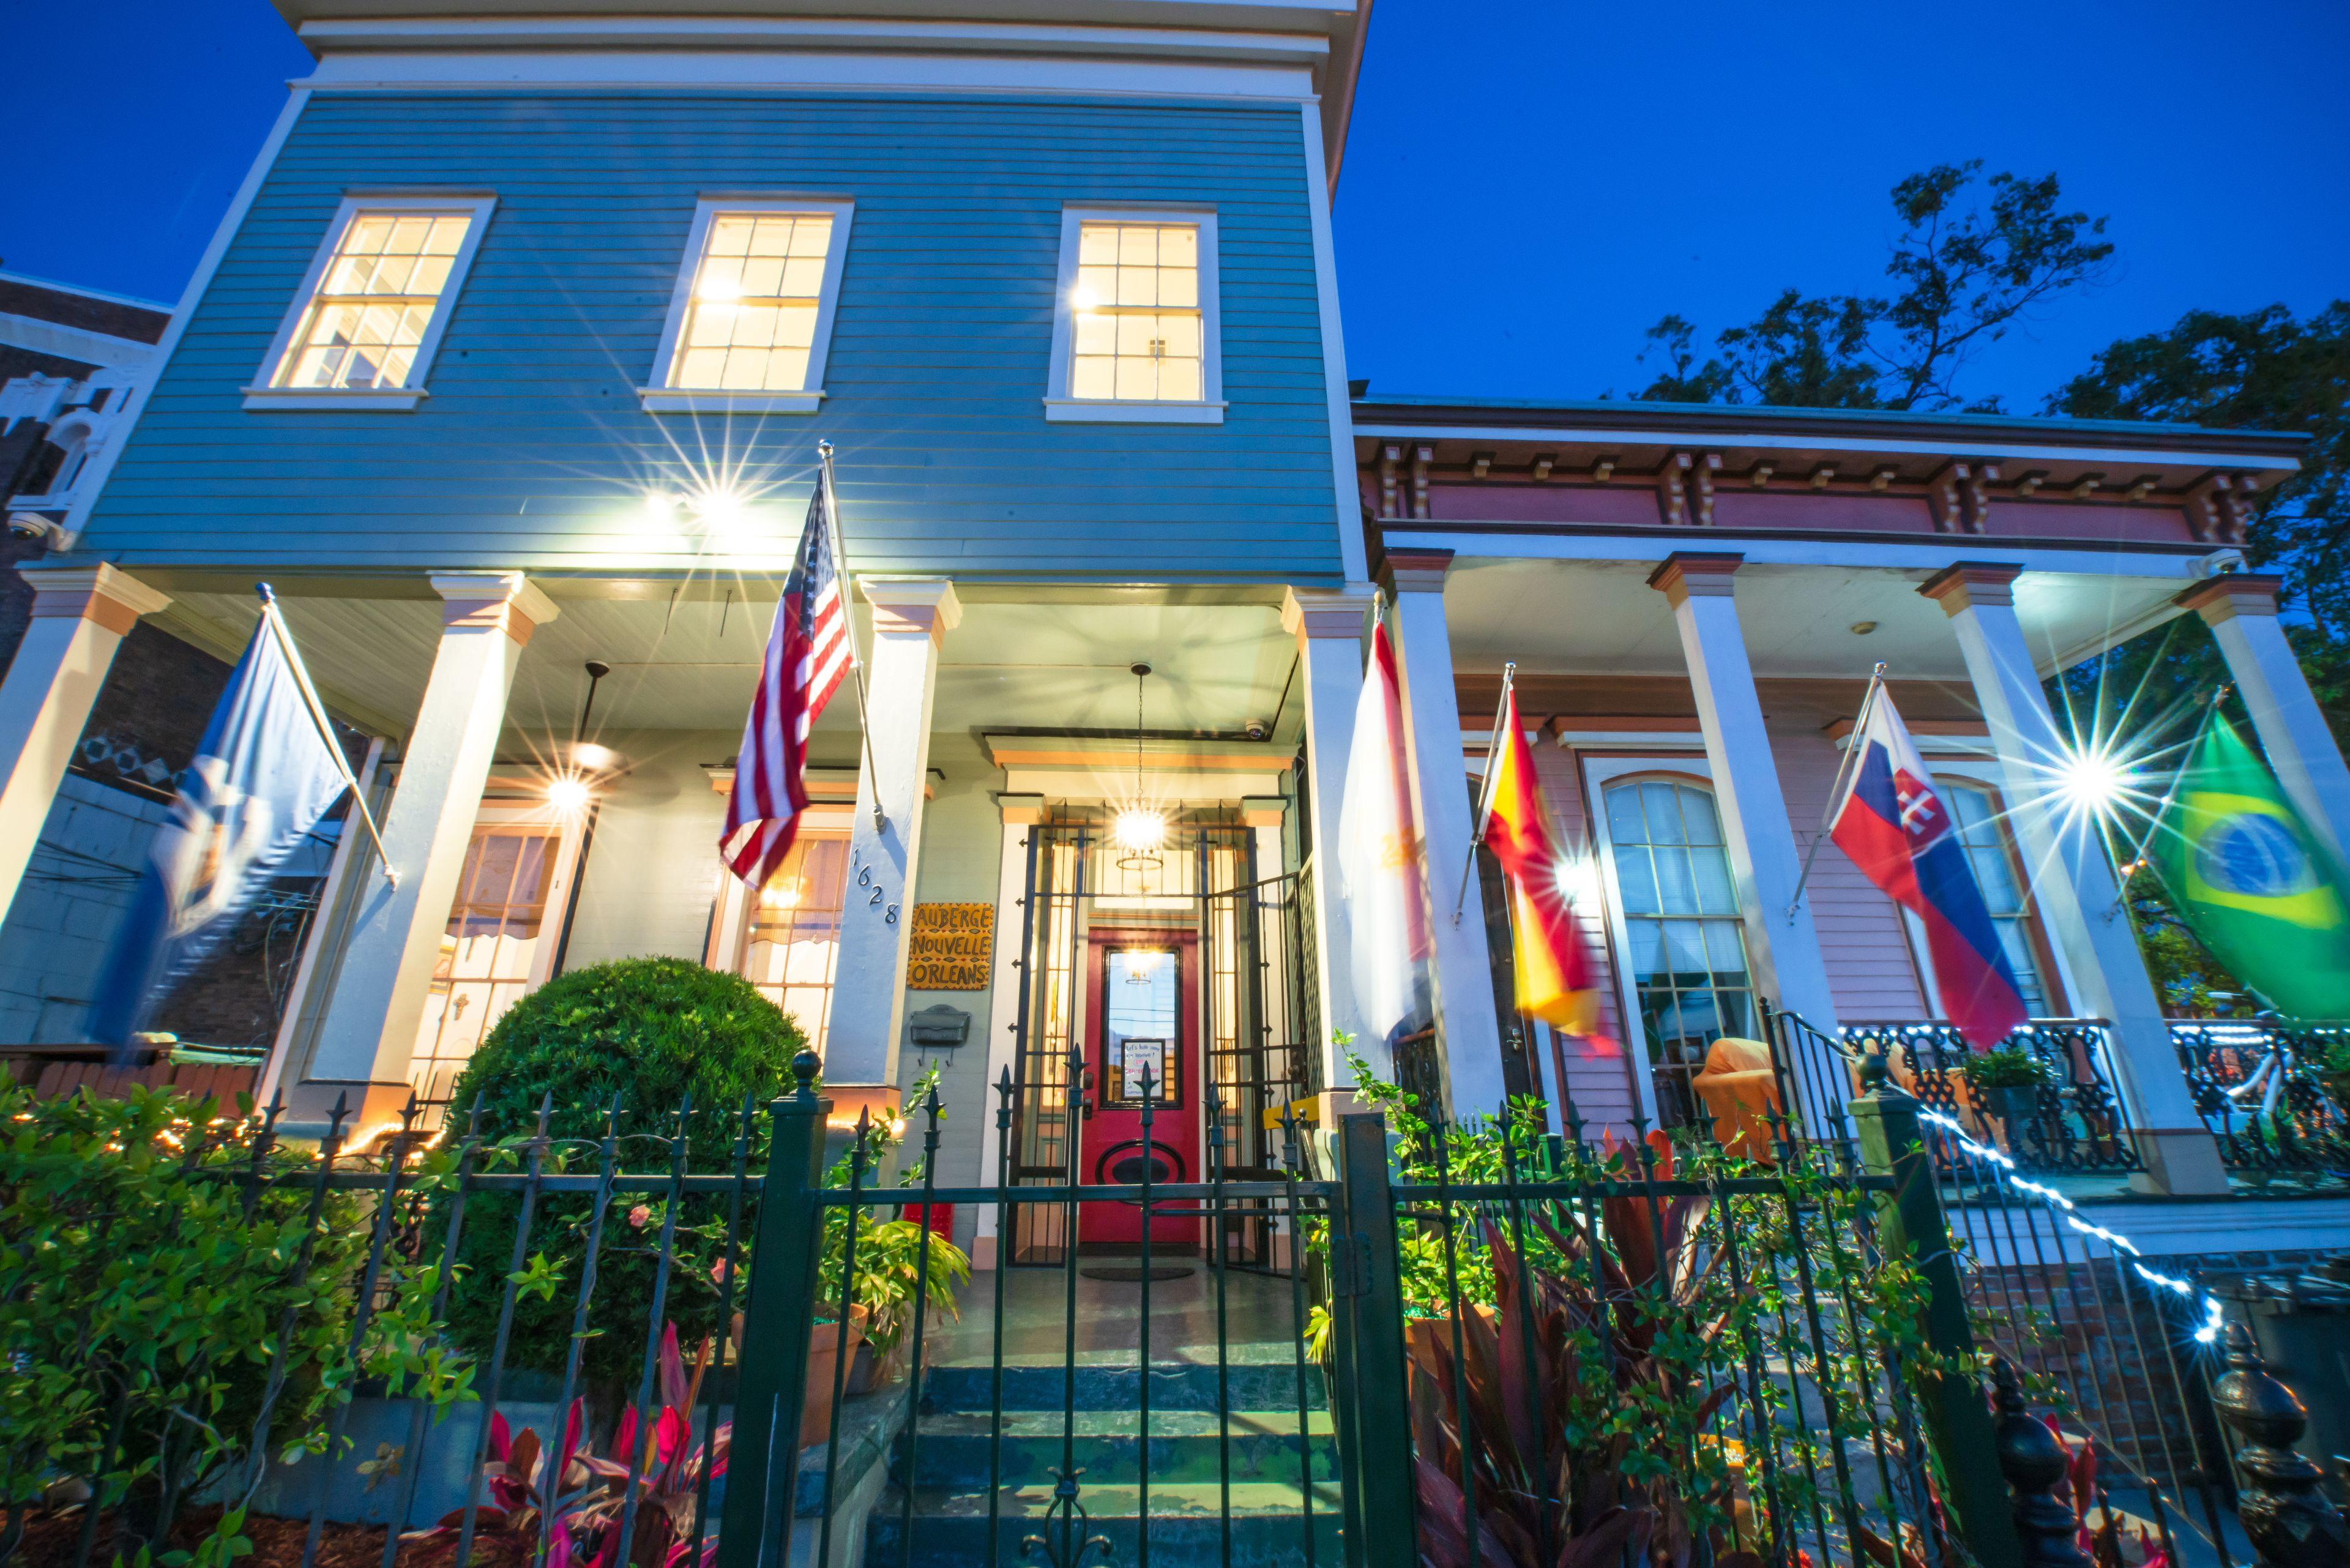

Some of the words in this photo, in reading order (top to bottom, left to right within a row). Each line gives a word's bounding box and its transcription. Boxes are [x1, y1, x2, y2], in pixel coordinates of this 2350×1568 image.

[852, 848, 899, 924] 1628
[915, 907, 991, 928] AUBERGE
[912, 935, 990, 956] NOUVELLE
[912, 964, 987, 985] ORLEANS
